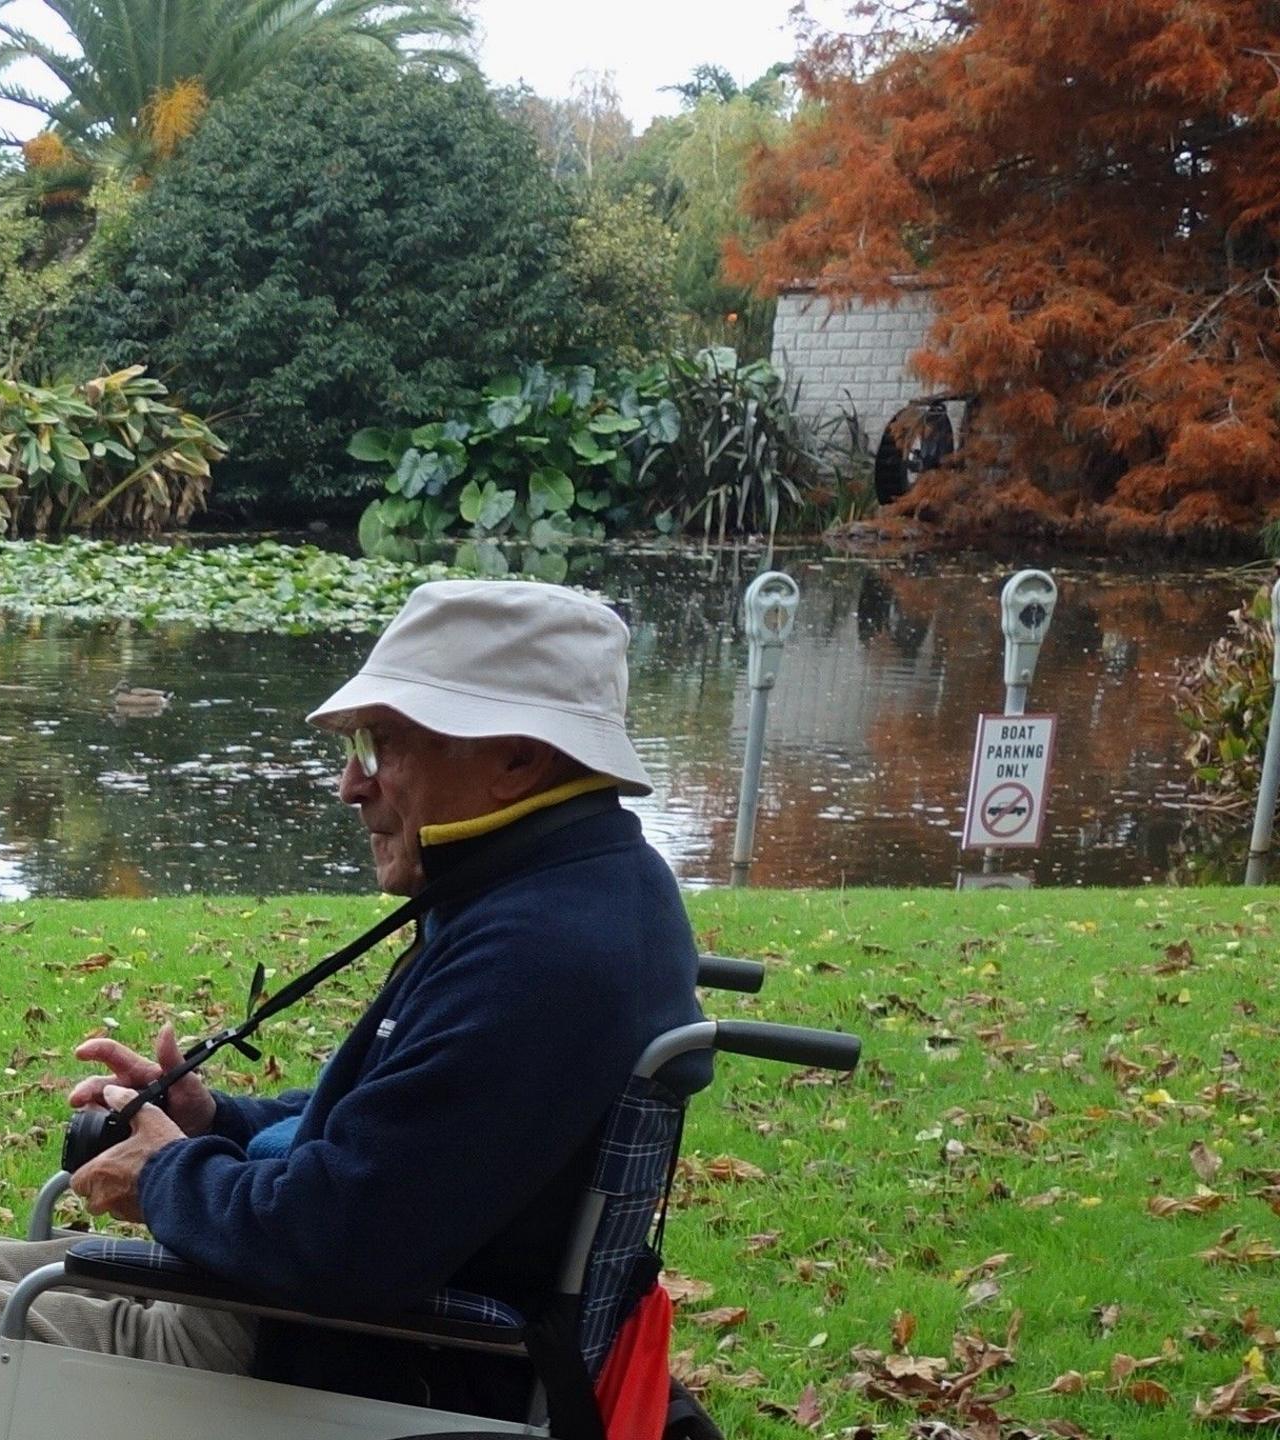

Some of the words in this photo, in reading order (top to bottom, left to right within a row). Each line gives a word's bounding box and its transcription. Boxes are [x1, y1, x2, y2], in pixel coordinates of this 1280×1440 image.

[1001, 725, 1035, 740] BOAT
[986, 744, 1044, 759] PARKING
[996, 764, 1029, 778] ONLY
